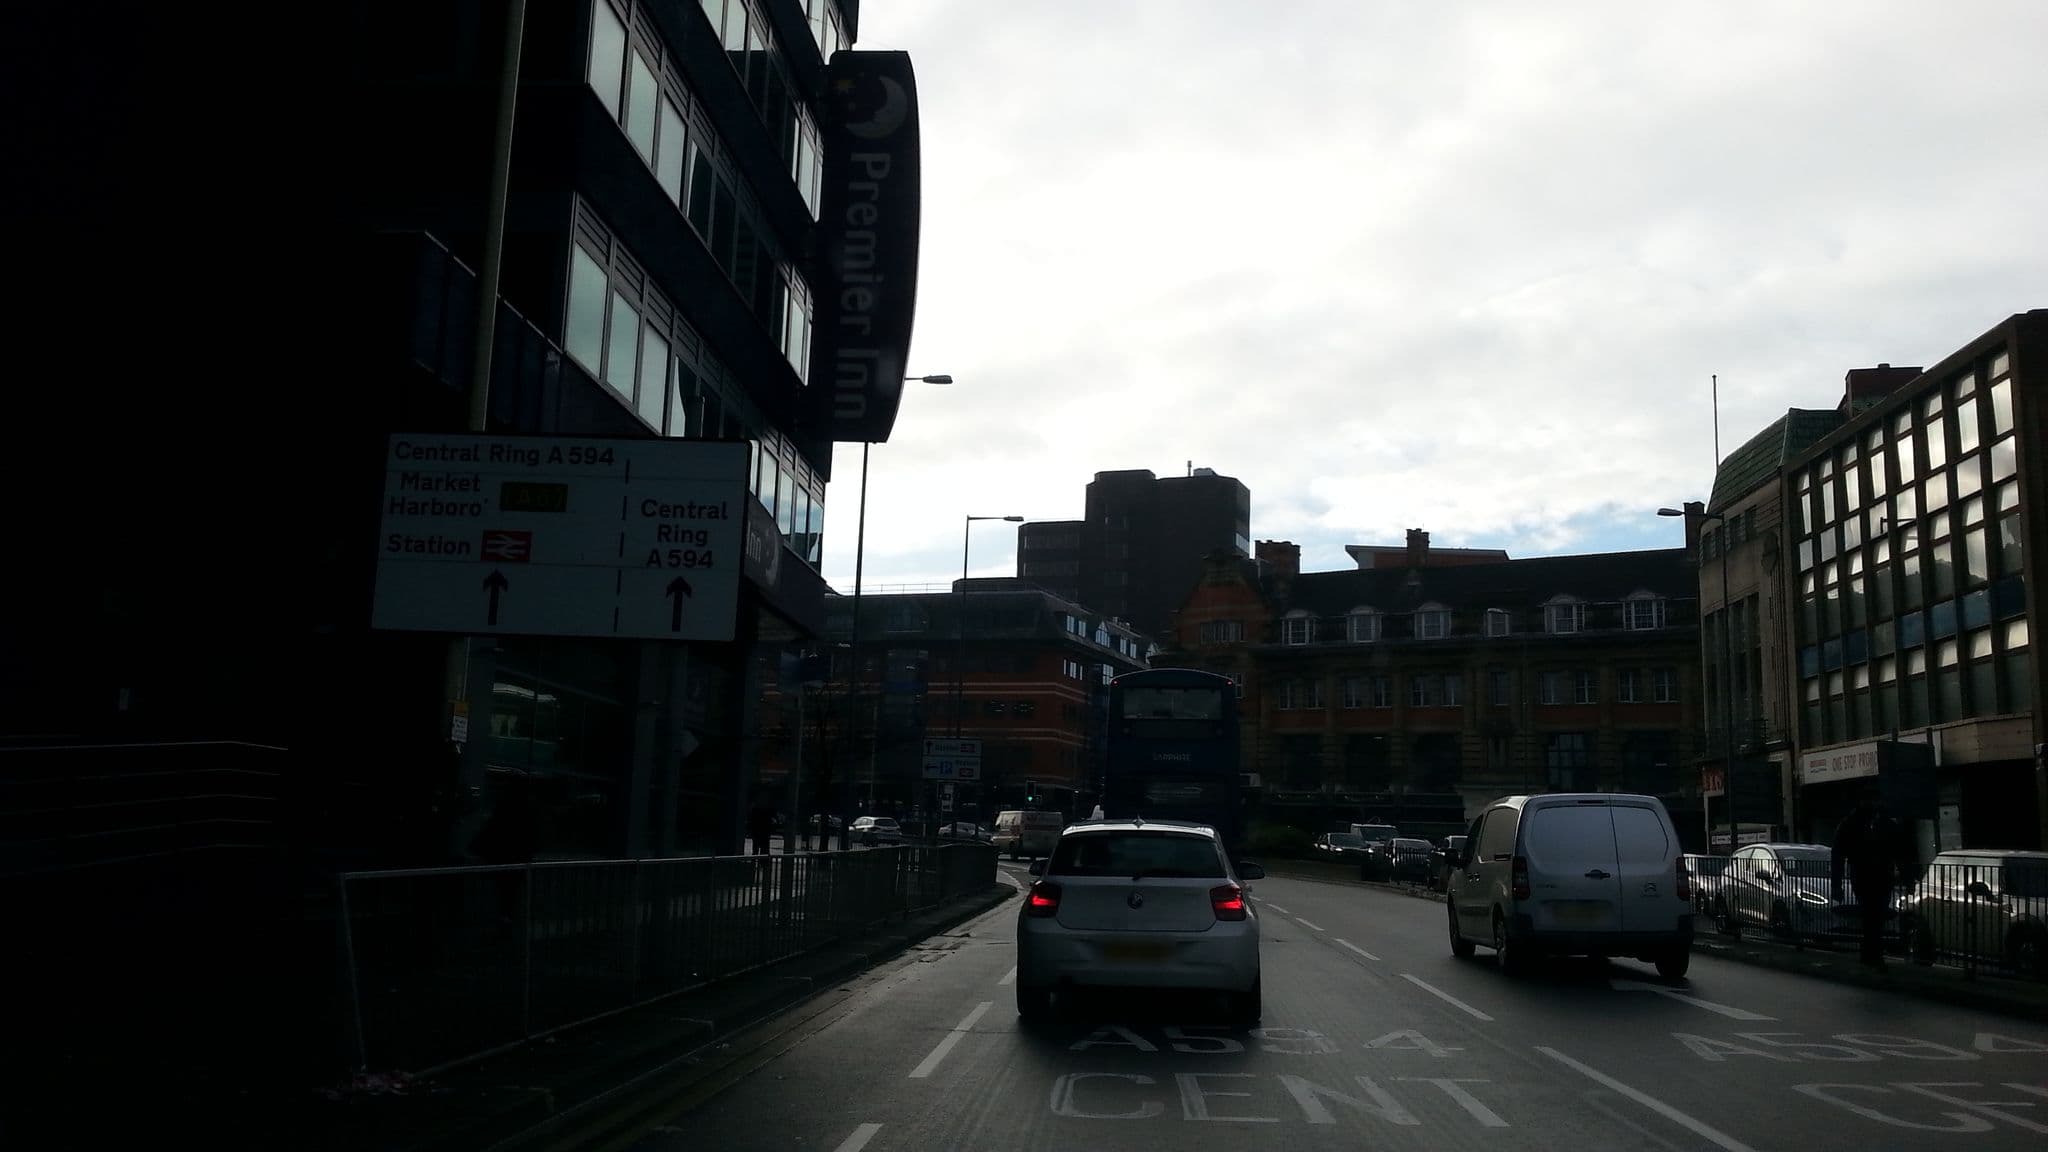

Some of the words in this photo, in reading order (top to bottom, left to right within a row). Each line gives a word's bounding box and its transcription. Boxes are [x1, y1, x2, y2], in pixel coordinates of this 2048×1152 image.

[839, 151, 892, 338] Premier
[833, 348, 881, 421] Inn
[394, 441, 480, 463] Central
[489, 444, 540, 467] Ring
[399, 471, 481, 492] Market
[640, 499, 728, 521] Central
[386, 533, 471, 555] Station
[656, 524, 708, 547] Ring
[1068, 1025, 1465, 1058] A594
[1049, 1071, 1511, 1128] CENT
